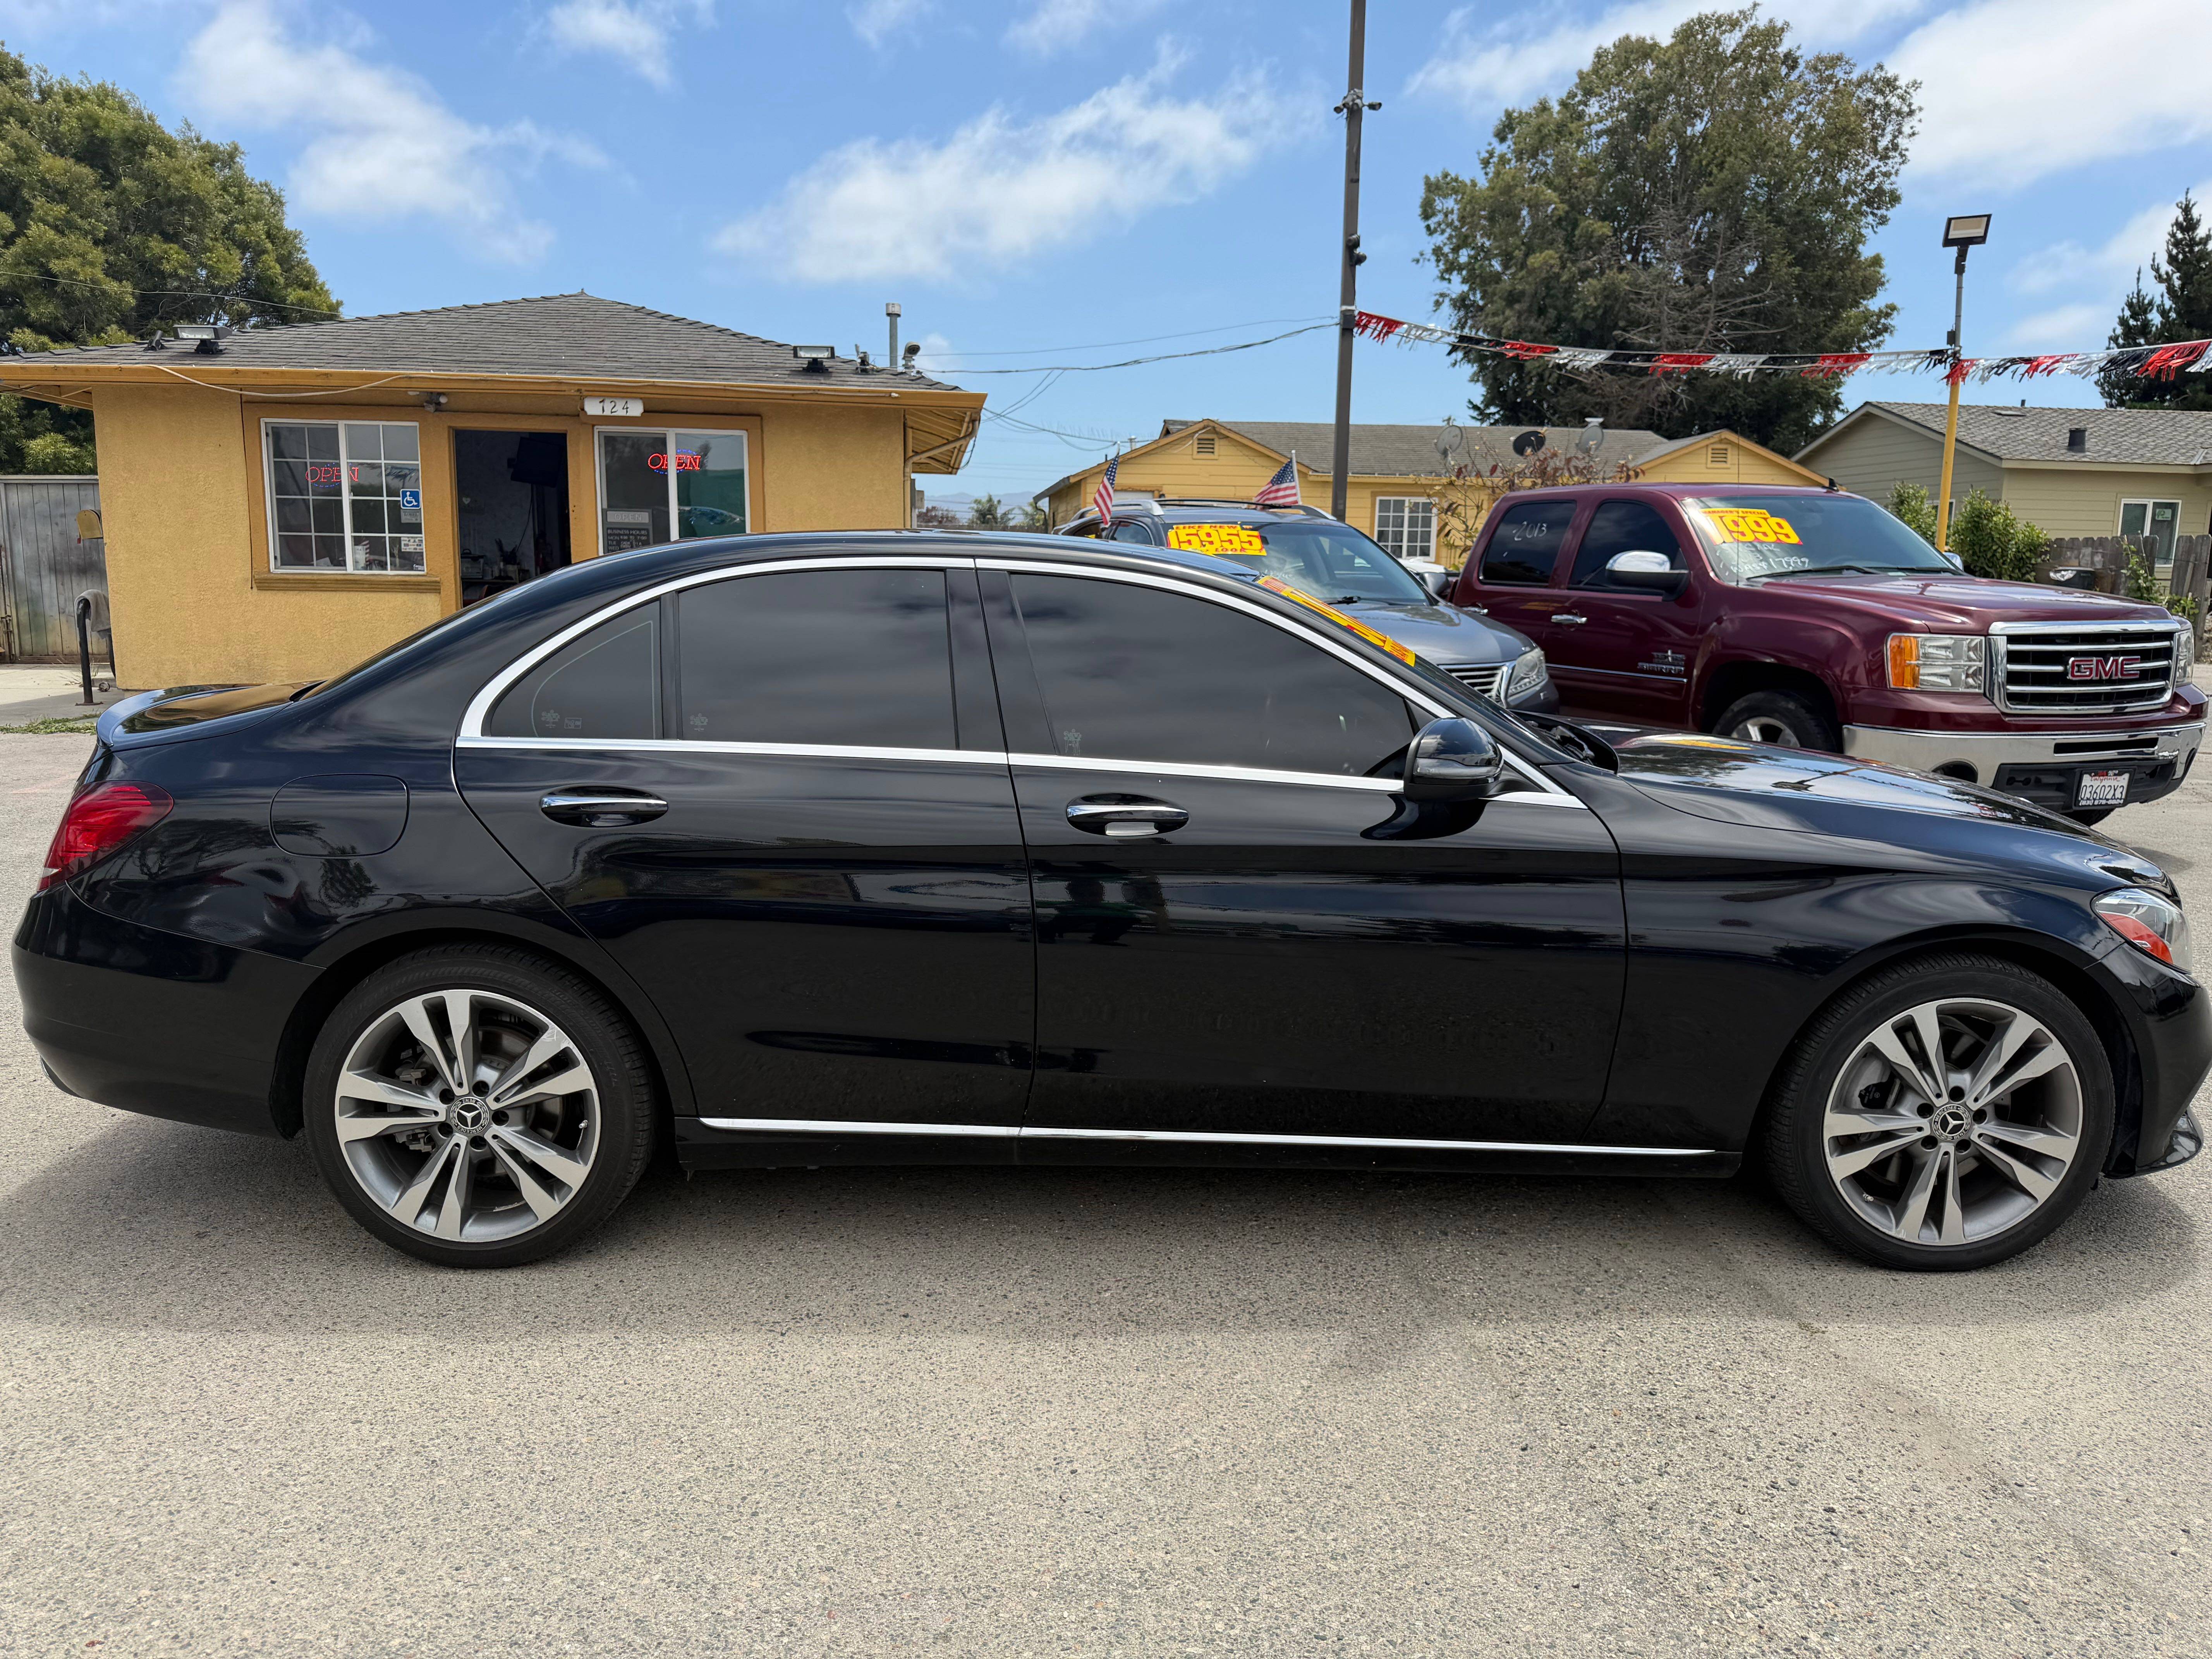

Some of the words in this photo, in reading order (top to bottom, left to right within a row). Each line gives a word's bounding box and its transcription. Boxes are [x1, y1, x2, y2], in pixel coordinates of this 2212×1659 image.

[305, 467, 359, 483] OPEN
[1167, 529, 1263, 551] 15955
[2067, 656, 2141, 680] GMC
[2080, 784, 2125, 800] 03602X3
[1934, 1106, 1957, 1121] MERCEDES
[457, 1125, 483, 1133] MERCEDES
